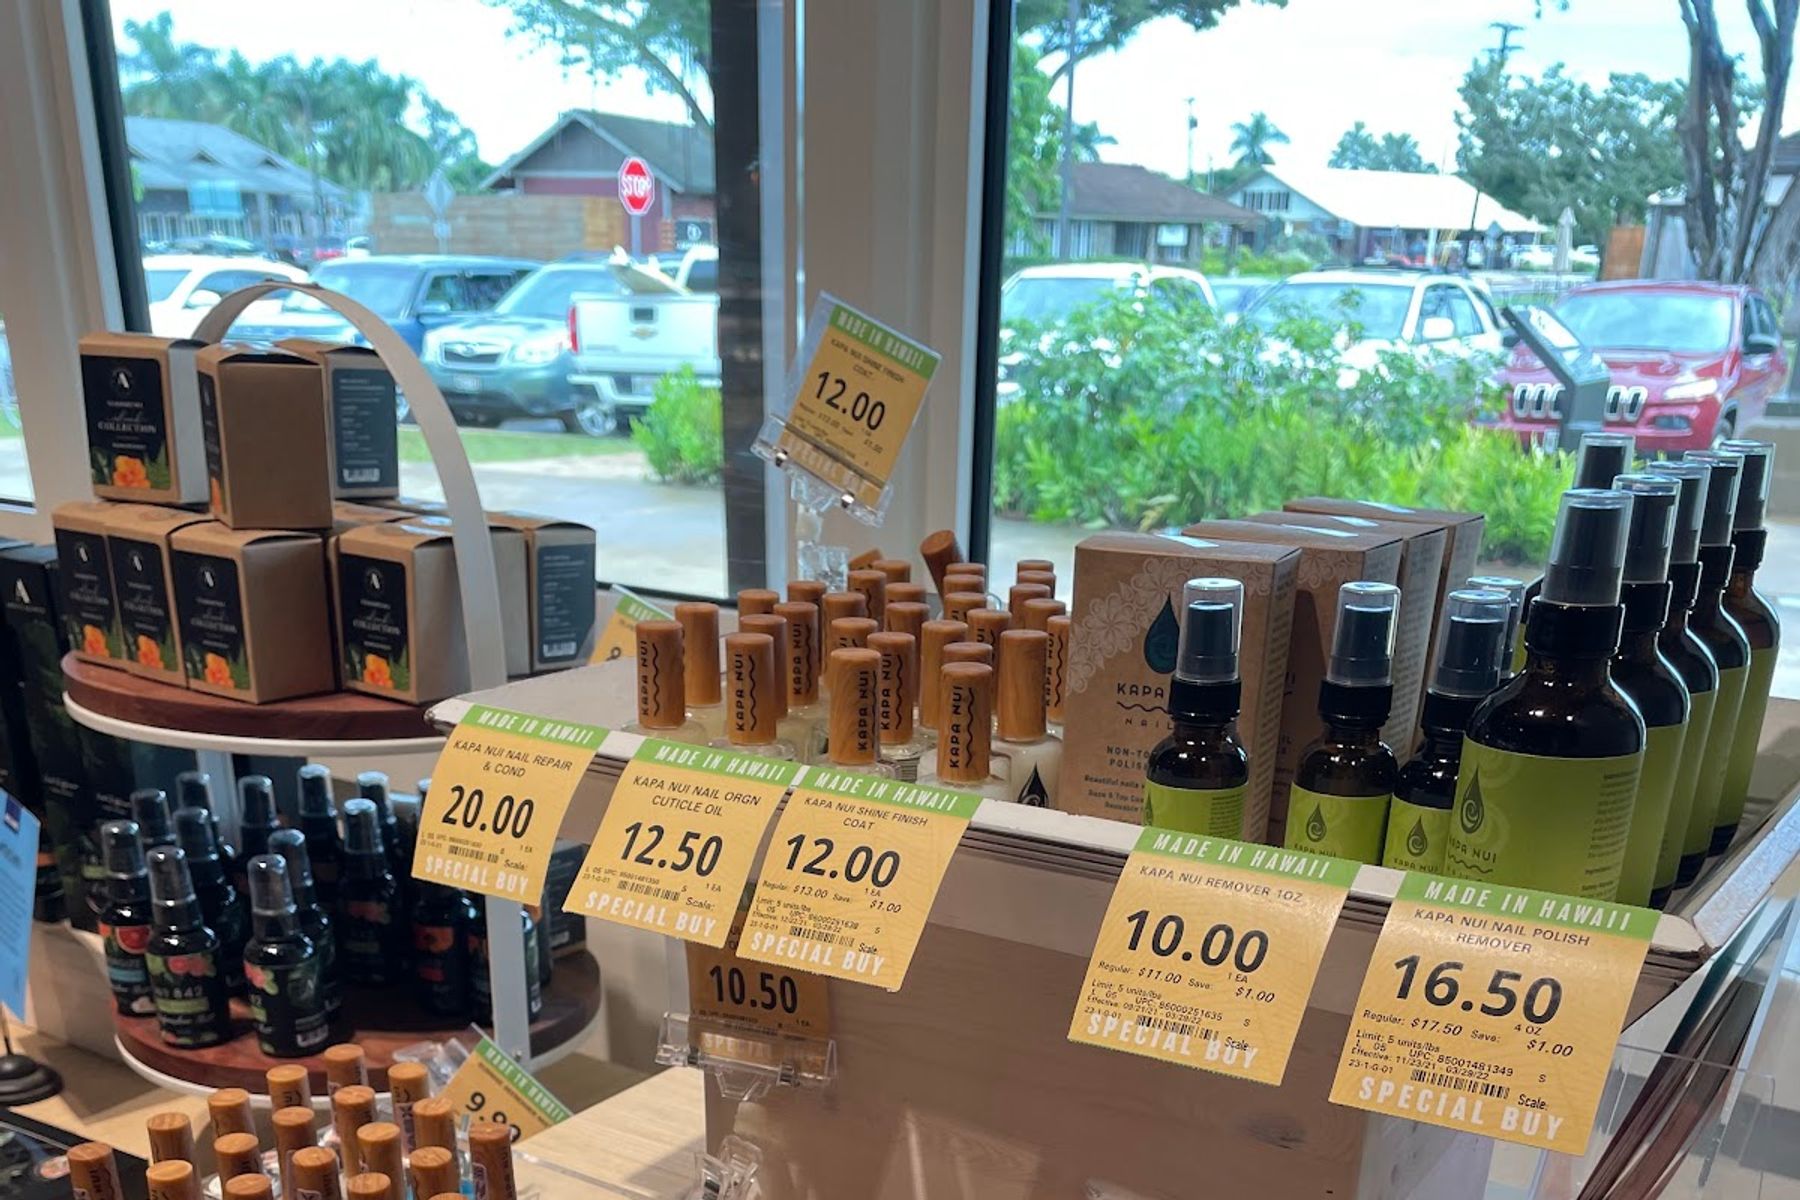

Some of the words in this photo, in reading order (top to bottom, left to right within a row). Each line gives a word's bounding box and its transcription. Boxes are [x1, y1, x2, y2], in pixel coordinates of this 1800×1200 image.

[621, 175, 652, 197] STOP
[838, 311, 866, 340] MADE
[869, 330, 883, 345] IN
[886, 339, 923, 369] HAWAII
[816, 372, 885, 430] 12.00
[735, 654, 745, 680] NUI
[882, 654, 892, 679] NUI
[860, 671, 869, 697] NUI
[952, 686, 963, 714] NUI
[1117, 682, 1164, 698] KAPA
[735, 689, 745, 731] KAPA
[881, 690, 891, 729] KAPA
[477, 710, 517, 730] MADE
[520, 719, 538, 734] IN
[540, 722, 594, 744] HAWAII
[858, 707, 868, 750] KAPA
[453, 740, 482, 753] KAPA
[484, 746, 504, 757] NUI
[505, 749, 529, 764] NAIL
[532, 755, 573, 771] REPAIR
[655, 745, 696, 766] MADE
[702, 753, 722, 769] IN
[726, 758, 787, 781] HAWAII
[950, 724, 960, 768] KAPA
[1107, 745, 1150, 758] NON-TO
[483, 762, 491, 771] &
[494, 764, 525, 778] COND
[633, 775, 664, 790] KAPA
[668, 781, 691, 794] NUI
[692, 786, 719, 800] NAIL
[724, 791, 762, 806] ORGN
[652, 795, 703, 813] CUTICLE
[704, 804, 723, 816] OIL
[815, 772, 863, 794] MADE
[867, 782, 888, 798] IN
[893, 786, 958, 812] HAWAII
[441, 785, 534, 838] 20.00
[804, 797, 832, 811] KAPA
[836, 802, 856, 814] NUI
[857, 805, 890, 820] SHINE
[892, 811, 928, 826] FINISH
[843, 817, 875, 830] COAT
[620, 822, 723, 877] 12.50
[786, 834, 900, 888] 12.00
[1153, 833, 1212, 858] MADE
[1218, 845, 1244, 864] IN
[1250, 849, 1331, 880] HAWAII
[1473, 849, 1496, 864] NUI
[425, 855, 488, 886] SPECIAL
[496, 871, 528, 895] BUY
[1140, 865, 1174, 881] KAPA
[1179, 871, 1203, 886] NUI
[1205, 876, 1270, 897] REMOVER
[585, 891, 666, 926] SPECIAL
[676, 909, 716, 938] BUY
[870, 900, 901, 913] $1.00
[1424, 881, 1493, 908] MADE
[1502, 894, 1527, 914] IN
[1540, 900, 1633, 931] HAWAII
[1126, 909, 1269, 973] 10.00
[1414, 908, 1454, 926] KAPA
[1461, 915, 1488, 931] NUI
[1491, 920, 1527, 937] NAIL
[1532, 928, 1591, 947] POLISH
[1456, 933, 1532, 955] REMOVER
[751, 932, 832, 967] SPECIAL
[843, 950, 885, 977] BUY
[710, 965, 798, 1014] 10.50
[1138, 968, 1182, 985] $11.00
[1235, 986, 1275, 1003] $1.00
[1235, 973, 1248, 984] EA
[1394, 955, 1563, 1024] 16.50
[1087, 1013, 1192, 1057] SPECIAL
[1205, 1038, 1260, 1070] BUY
[1356, 1029, 1384, 1042] Limit:
[1387, 1035, 1394, 1044] 5
[1397, 1037, 1440, 1052] units/lbs
[1362, 1009, 1405, 1026] Regular:
[1410, 1017, 1463, 1037] $17.50
[1470, 1030, 1501, 1043] Save:
[1526, 1039, 1574, 1057] $1.00
[1514, 1024, 1522, 1033] 4
[1525, 1026, 1543, 1036] OZ
[1351, 1047, 1391, 1061] Effective:
[1408, 1049, 1433, 1062] UPC:
[1359, 1077, 1484, 1125] SPECIAL
[1501, 1105, 1564, 1141] BUY
[1518, 1094, 1549, 1111] Scale:
